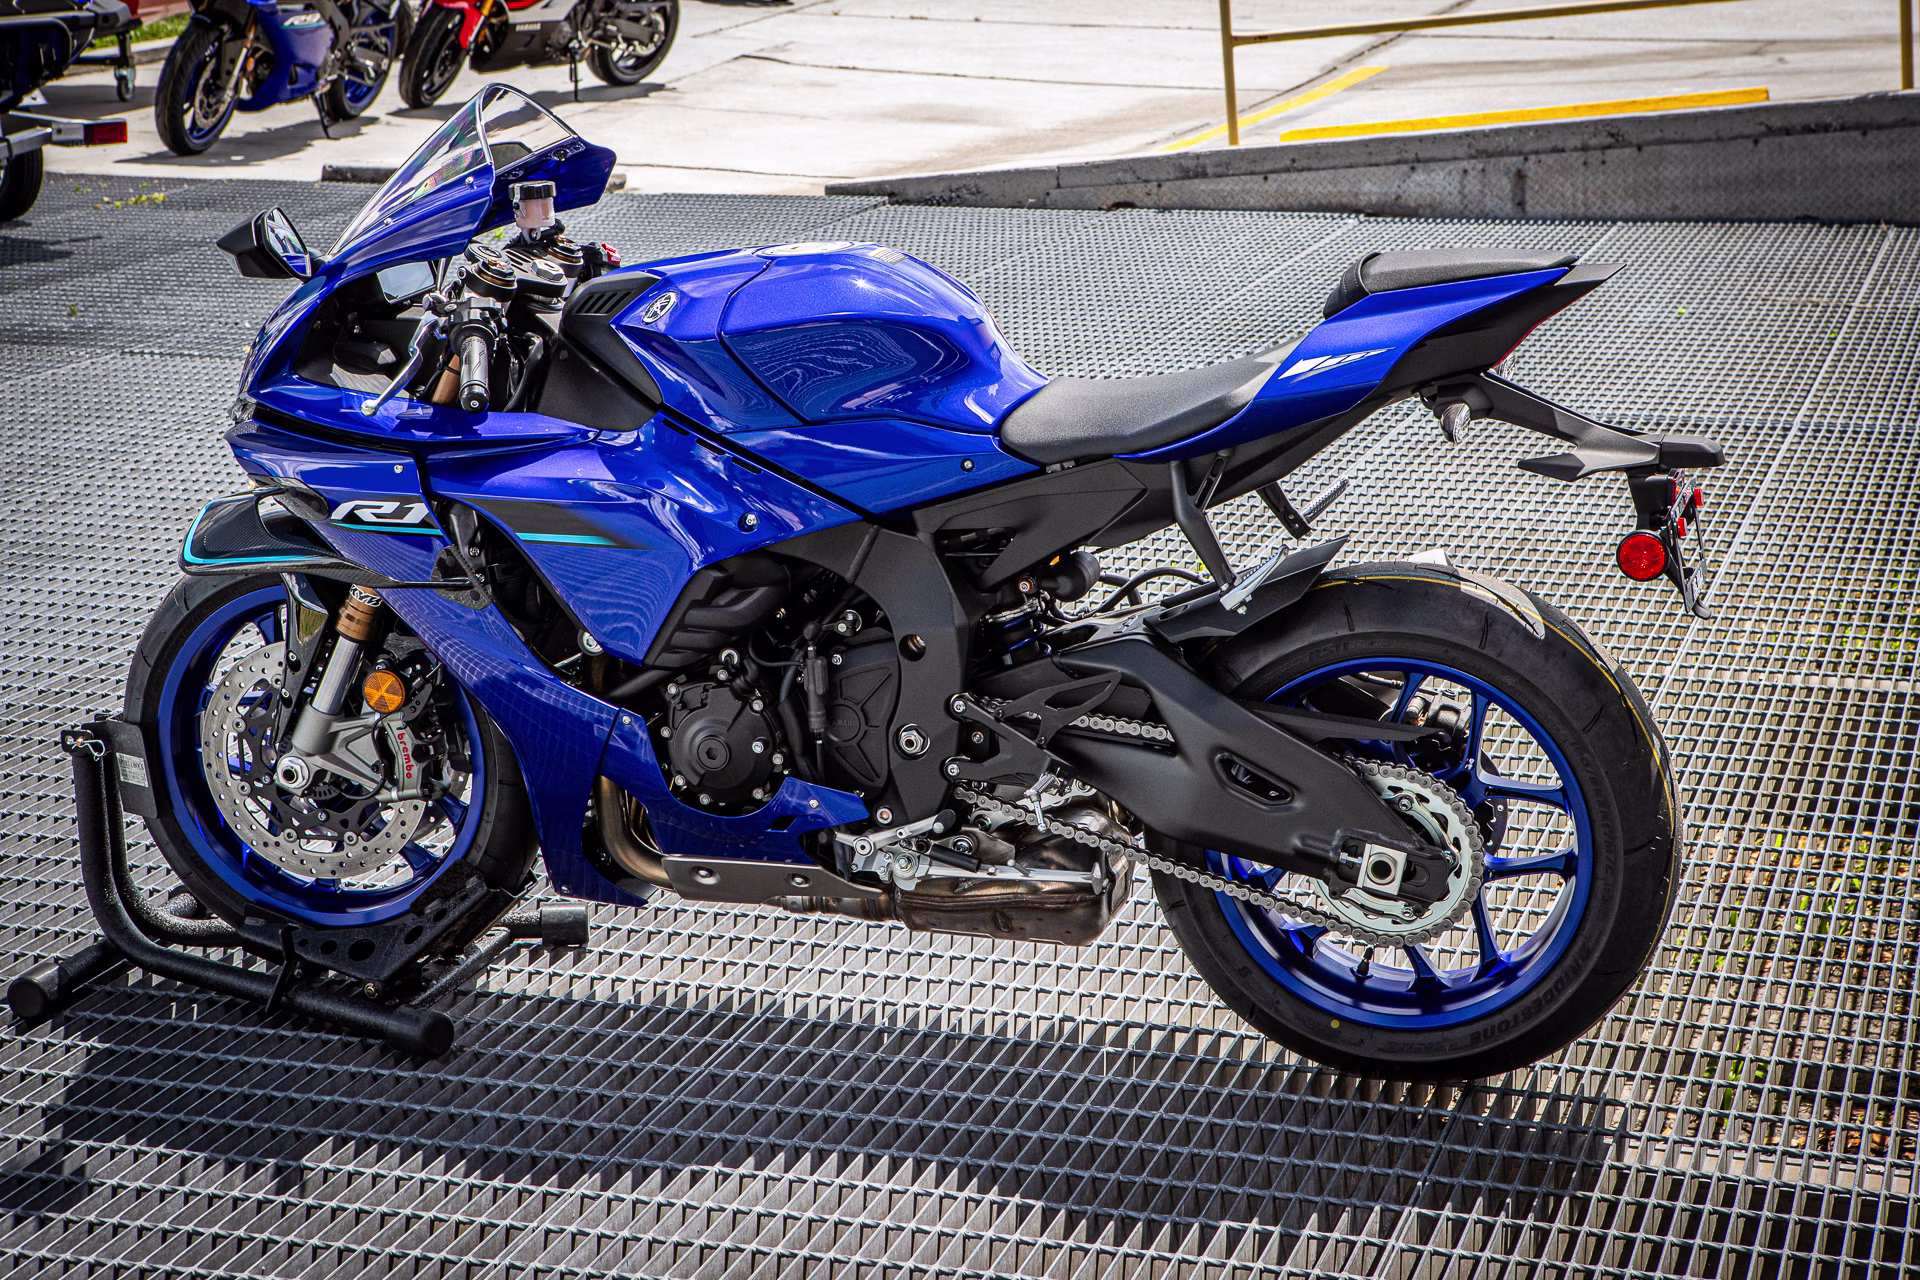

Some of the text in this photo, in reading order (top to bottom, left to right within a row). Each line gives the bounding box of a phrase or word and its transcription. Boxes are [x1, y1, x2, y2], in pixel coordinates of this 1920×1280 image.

[331, 500, 429, 523] R1
[350, 584, 382, 608] KYB
[397, 732, 413, 779] brembo
